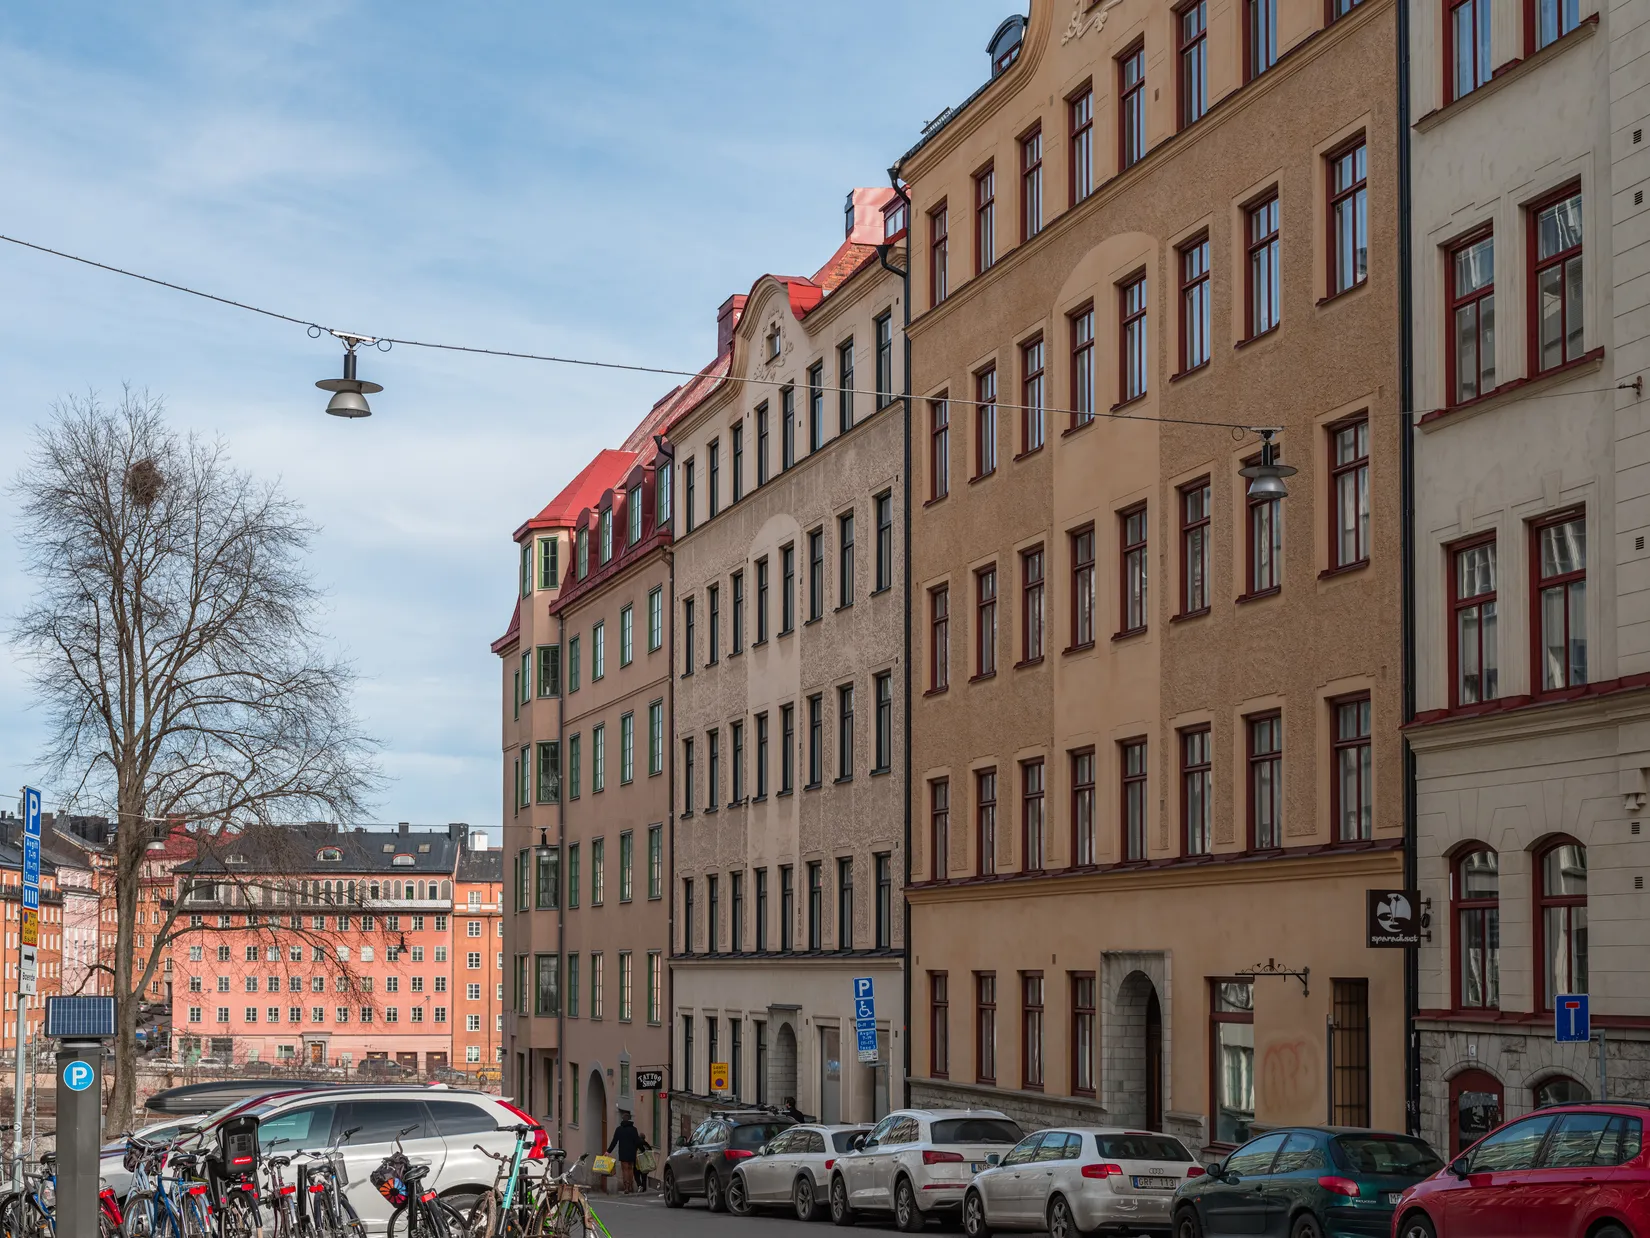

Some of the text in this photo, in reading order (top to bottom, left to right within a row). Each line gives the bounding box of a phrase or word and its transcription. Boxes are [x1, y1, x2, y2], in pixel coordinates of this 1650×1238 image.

[29, 792, 39, 830] P
[858, 979, 870, 997] P
[72, 1066, 88, 1086] P
[638, 1073, 662, 1083] TATTOO
[1138, 1176, 1175, 1187] GRF 113
